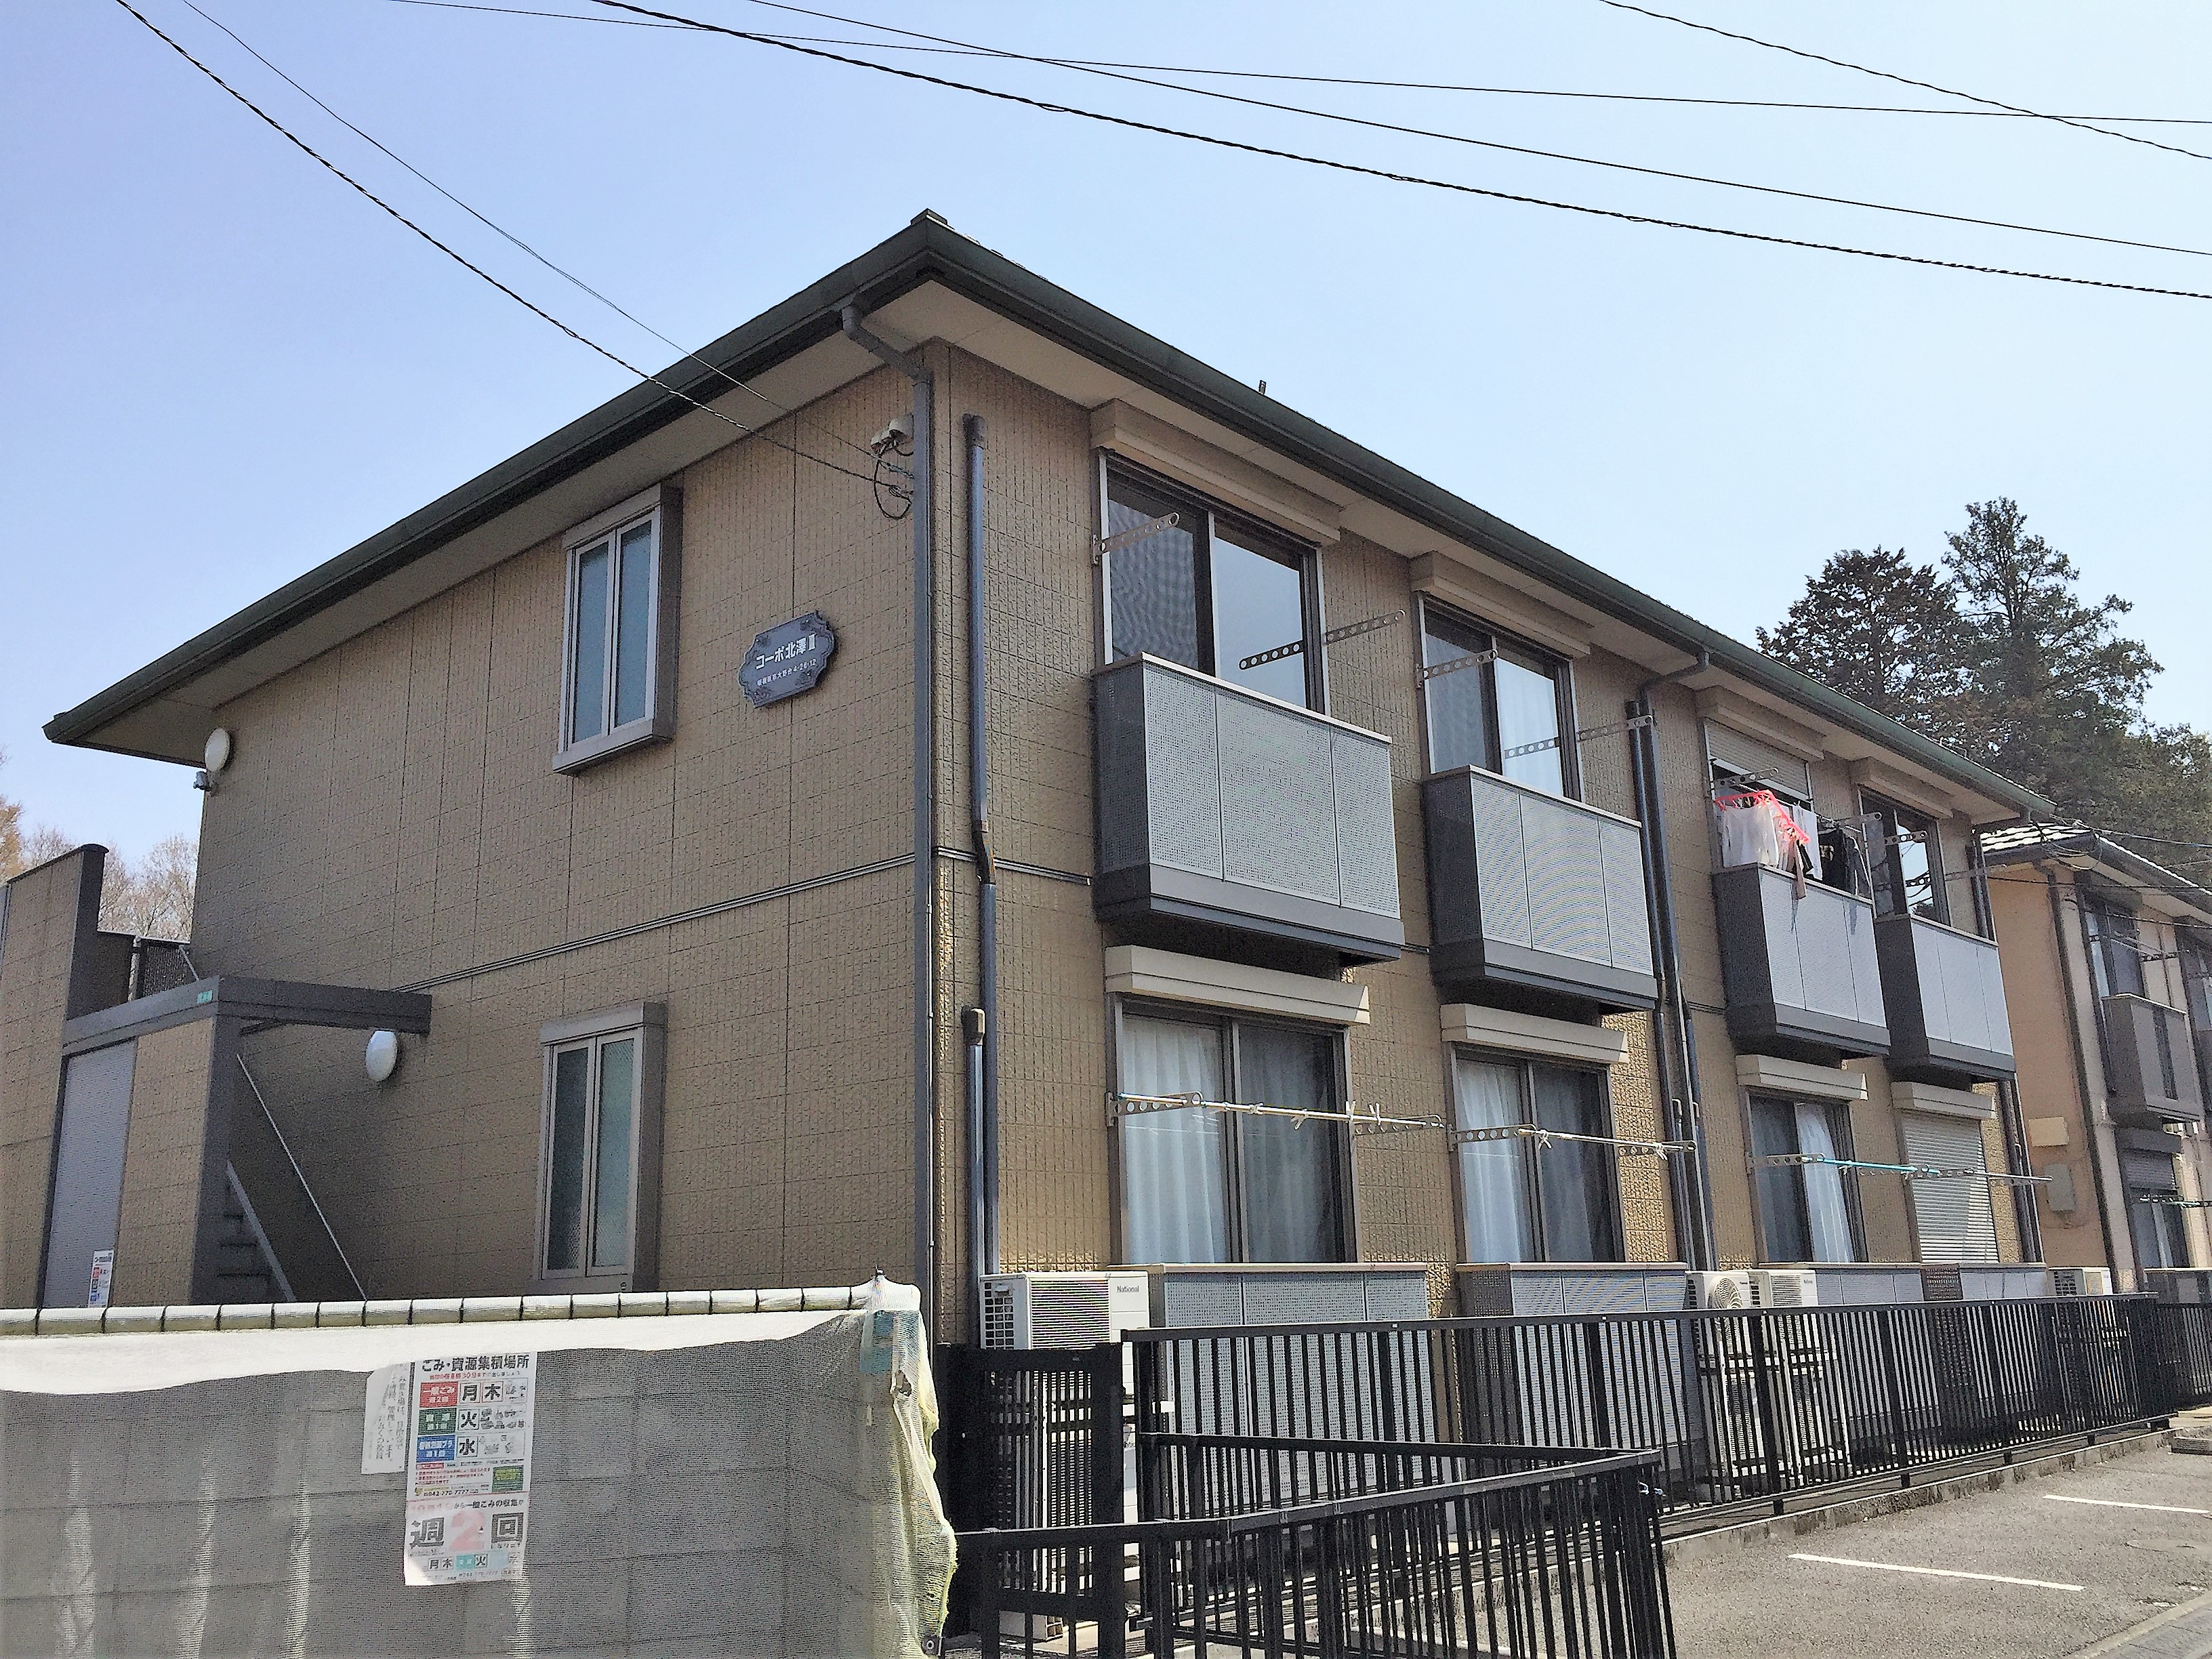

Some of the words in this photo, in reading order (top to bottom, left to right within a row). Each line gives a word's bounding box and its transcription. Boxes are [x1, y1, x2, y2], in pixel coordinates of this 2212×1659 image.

[1117, 1285, 1139, 1293] National
[462, 1385, 477, 1401] 月
[484, 1384, 501, 1400] 木
[461, 1412, 477, 1428] 火
[459, 1439, 476, 1455] 水
[430, 1559, 439, 1570] 月
[443, 1558, 453, 1569] 木
[475, 1556, 487, 1566] 火
